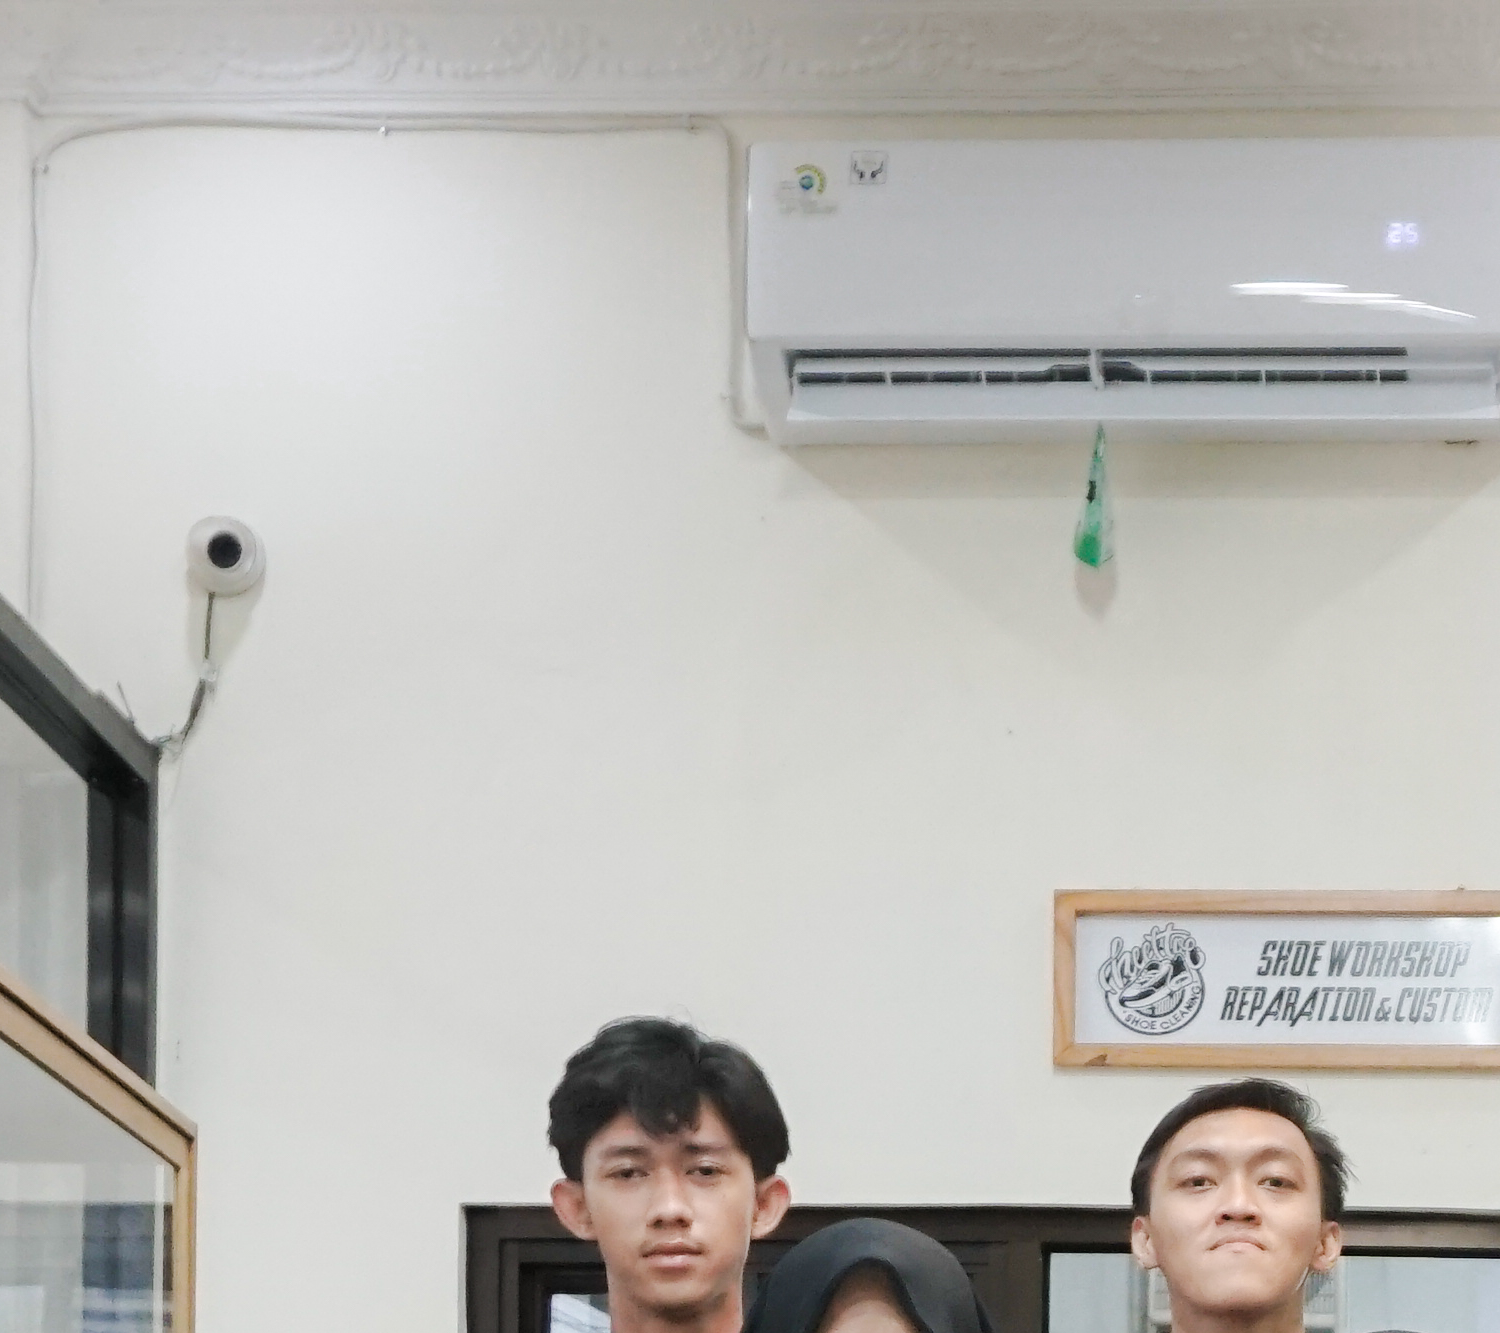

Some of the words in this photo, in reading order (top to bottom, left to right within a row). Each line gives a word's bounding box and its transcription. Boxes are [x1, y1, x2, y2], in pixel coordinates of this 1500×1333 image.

[1257, 940, 1327, 977] SHOE
[1327, 940, 1471, 978] WORKSHOP
[1124, 1013, 1158, 1030] SHOE
[1160, 982, 1202, 1030] CLEANING
[1220, 986, 1376, 1027] REPARATION
[1374, 996, 1392, 1022] &
